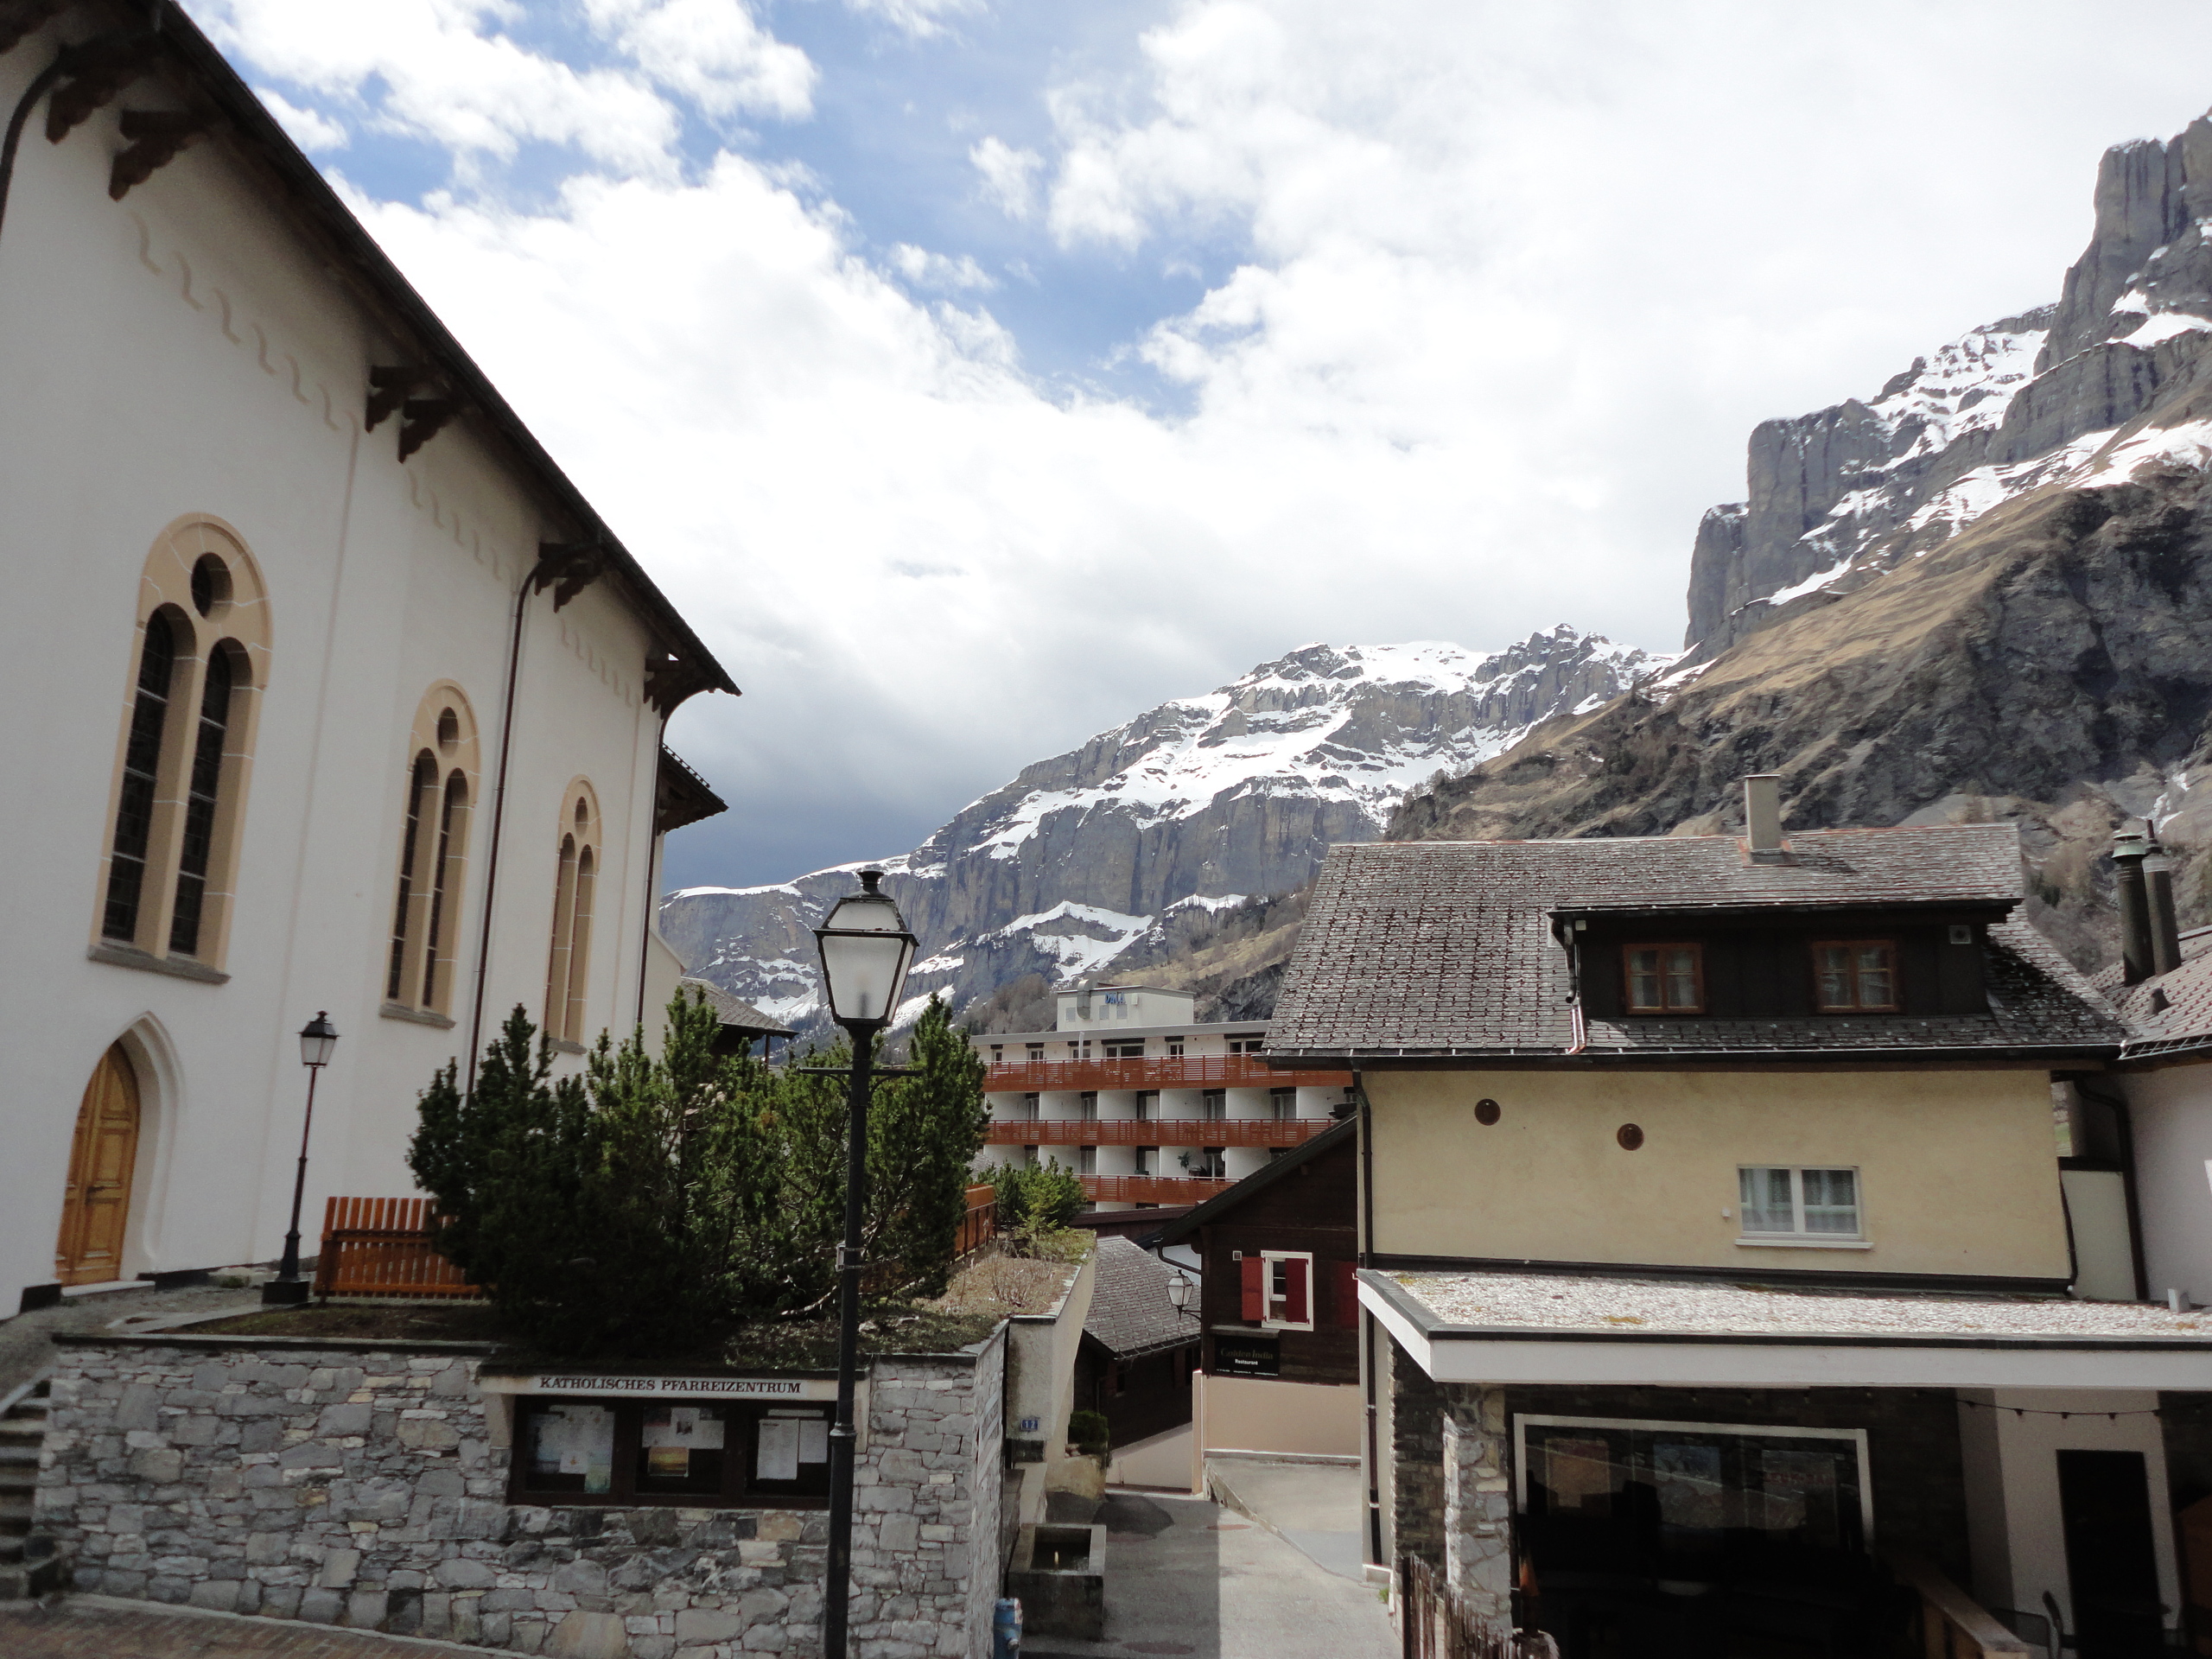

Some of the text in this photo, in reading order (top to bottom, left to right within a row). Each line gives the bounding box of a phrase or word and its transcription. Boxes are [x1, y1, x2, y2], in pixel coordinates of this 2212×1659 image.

[1220, 1347, 1274, 1360] Golden India
[539, 1376, 802, 1395] KATHOLISCHES PFARREIZENTRUM
